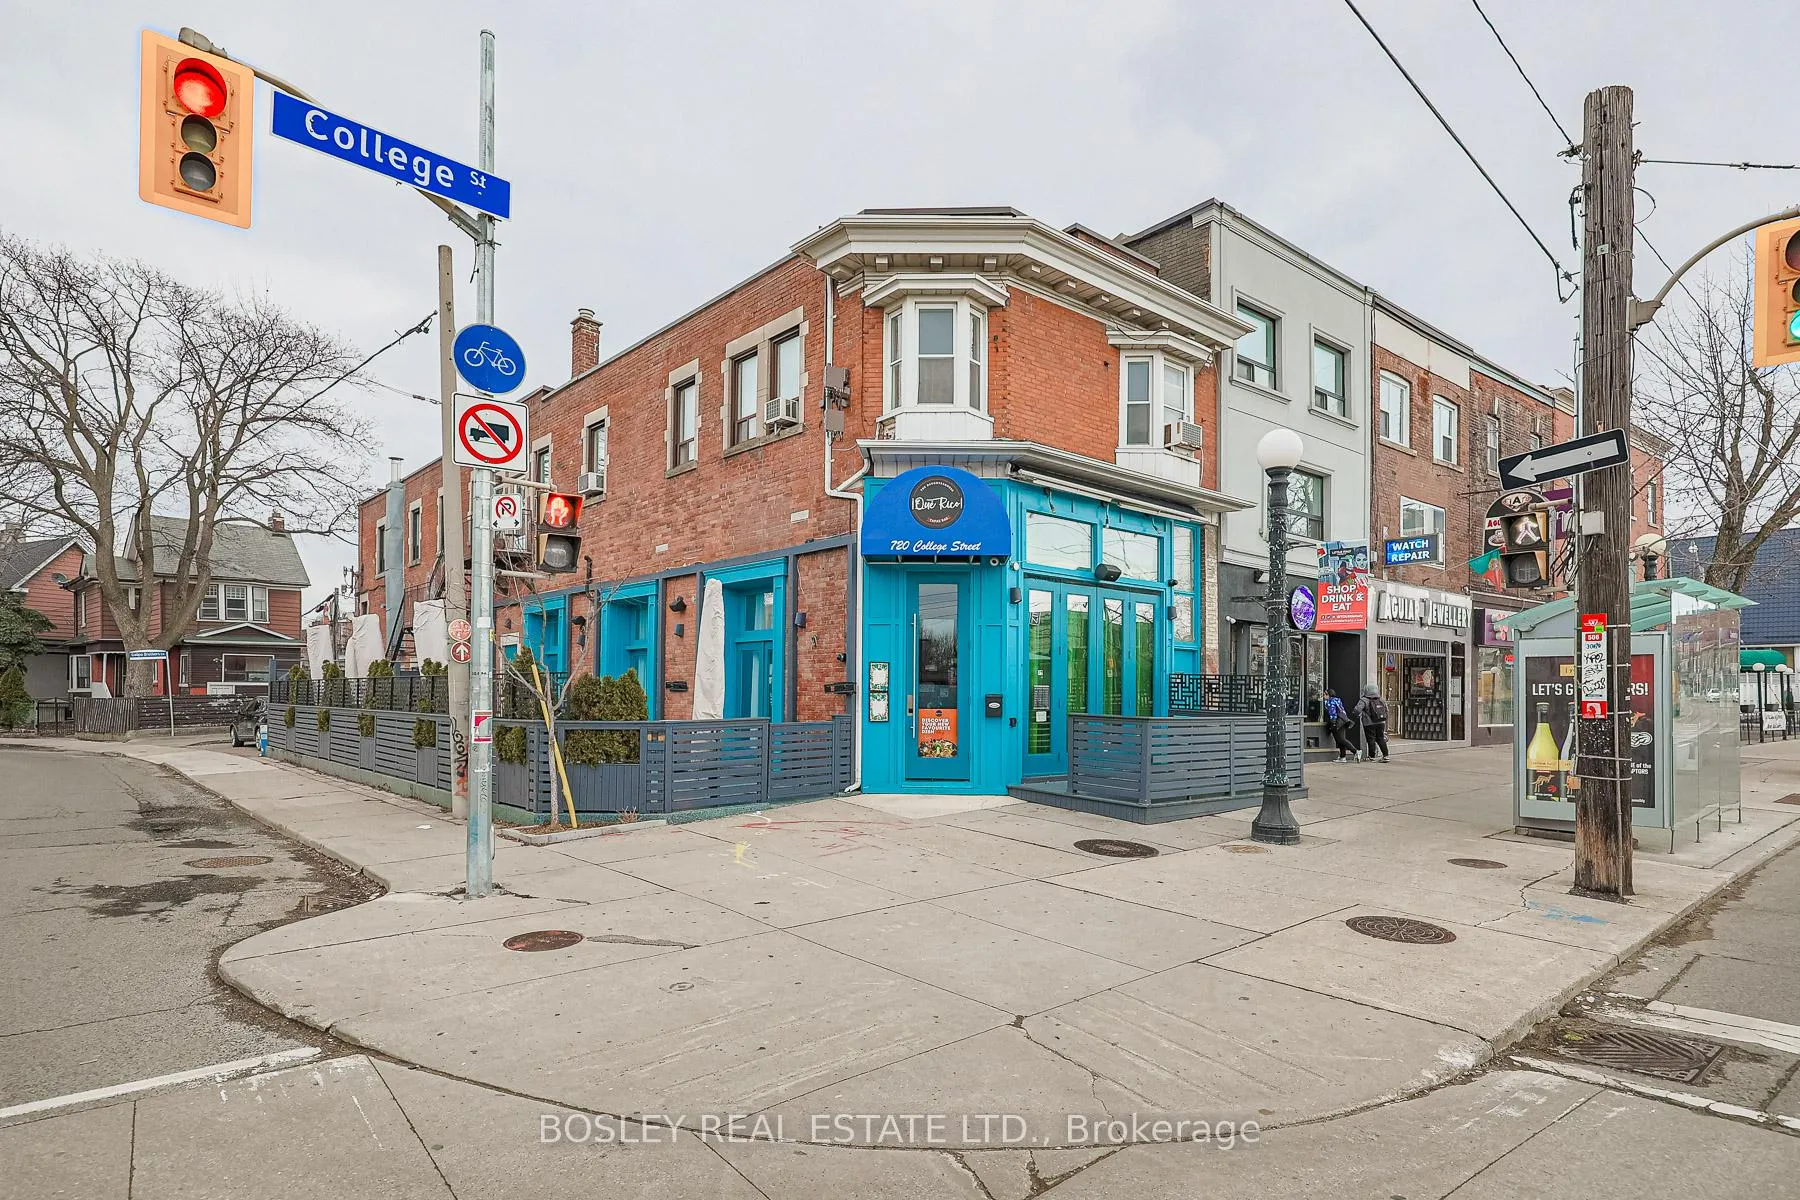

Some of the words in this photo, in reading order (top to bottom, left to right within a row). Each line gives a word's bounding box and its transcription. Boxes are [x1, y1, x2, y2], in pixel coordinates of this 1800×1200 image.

[304, 109, 455, 188] College
[469, 170, 487, 190] St
[890, 540, 910, 551] 720
[912, 539, 947, 553] College
[950, 540, 982, 551] Street
[1392, 539, 1429, 551] WATCH
[1391, 550, 1430, 562] REPAIR
[1326, 584, 1358, 595] SHOP,
[1321, 594, 1354, 603] DRINK
[1355, 592, 1364, 601] &
[1332, 602, 1352, 612] EAT
[1427, 600, 1472, 628] JEWELLERY
[1532, 683, 1563, 696] LET'S
[1565, 683, 1574, 696] G
